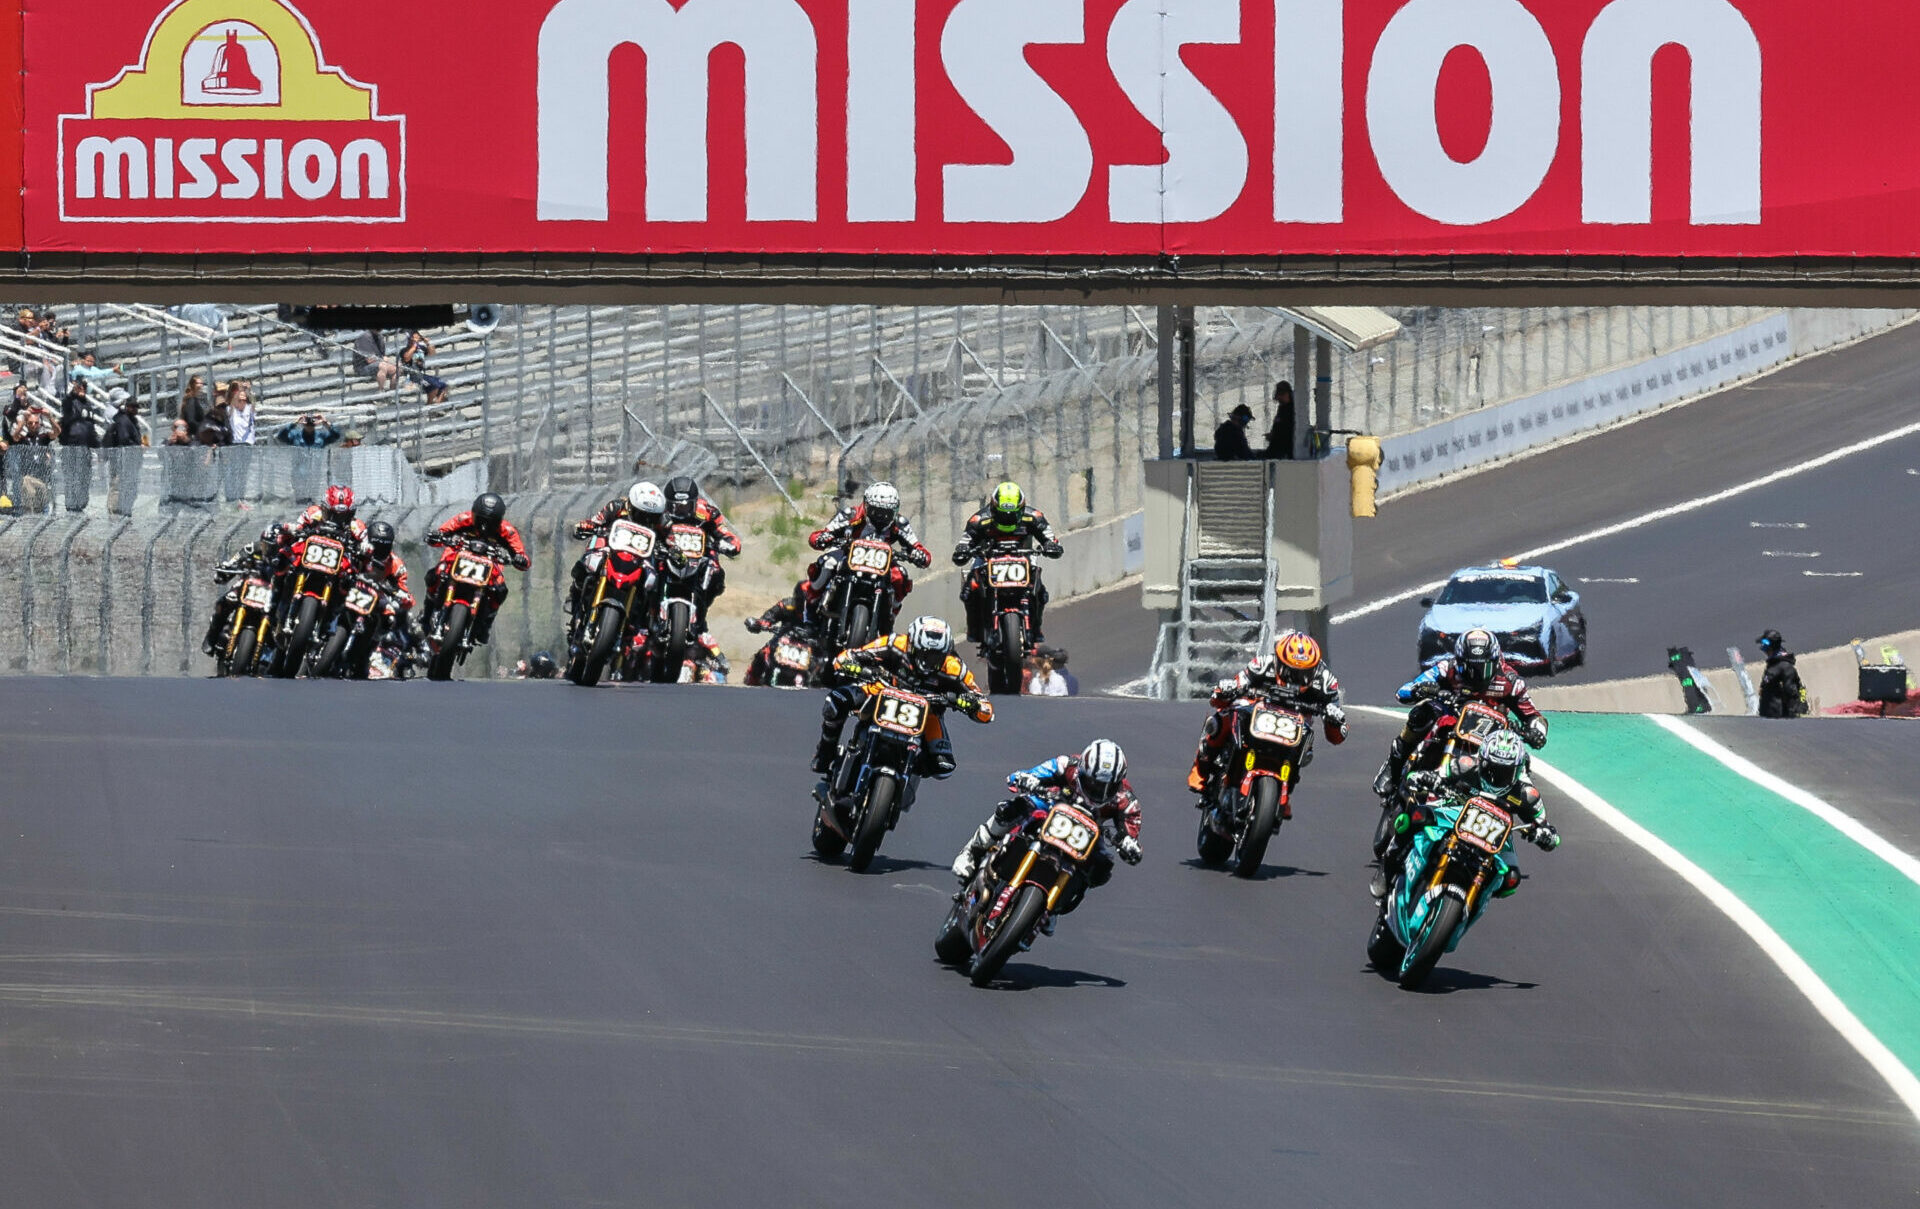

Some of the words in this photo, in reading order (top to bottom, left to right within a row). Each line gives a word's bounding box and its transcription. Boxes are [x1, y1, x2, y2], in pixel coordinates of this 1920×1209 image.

[537, 0, 1763, 226] MISSION
[75, 136, 390, 200] MISSION
[305, 544, 339, 569] 93
[458, 559, 485, 581] 71
[851, 547, 888, 569] 249
[992, 564, 1025, 582] 70
[881, 699, 921, 728] 13
[1049, 814, 1090, 850] 99
[1459, 808, 1507, 845] 137
